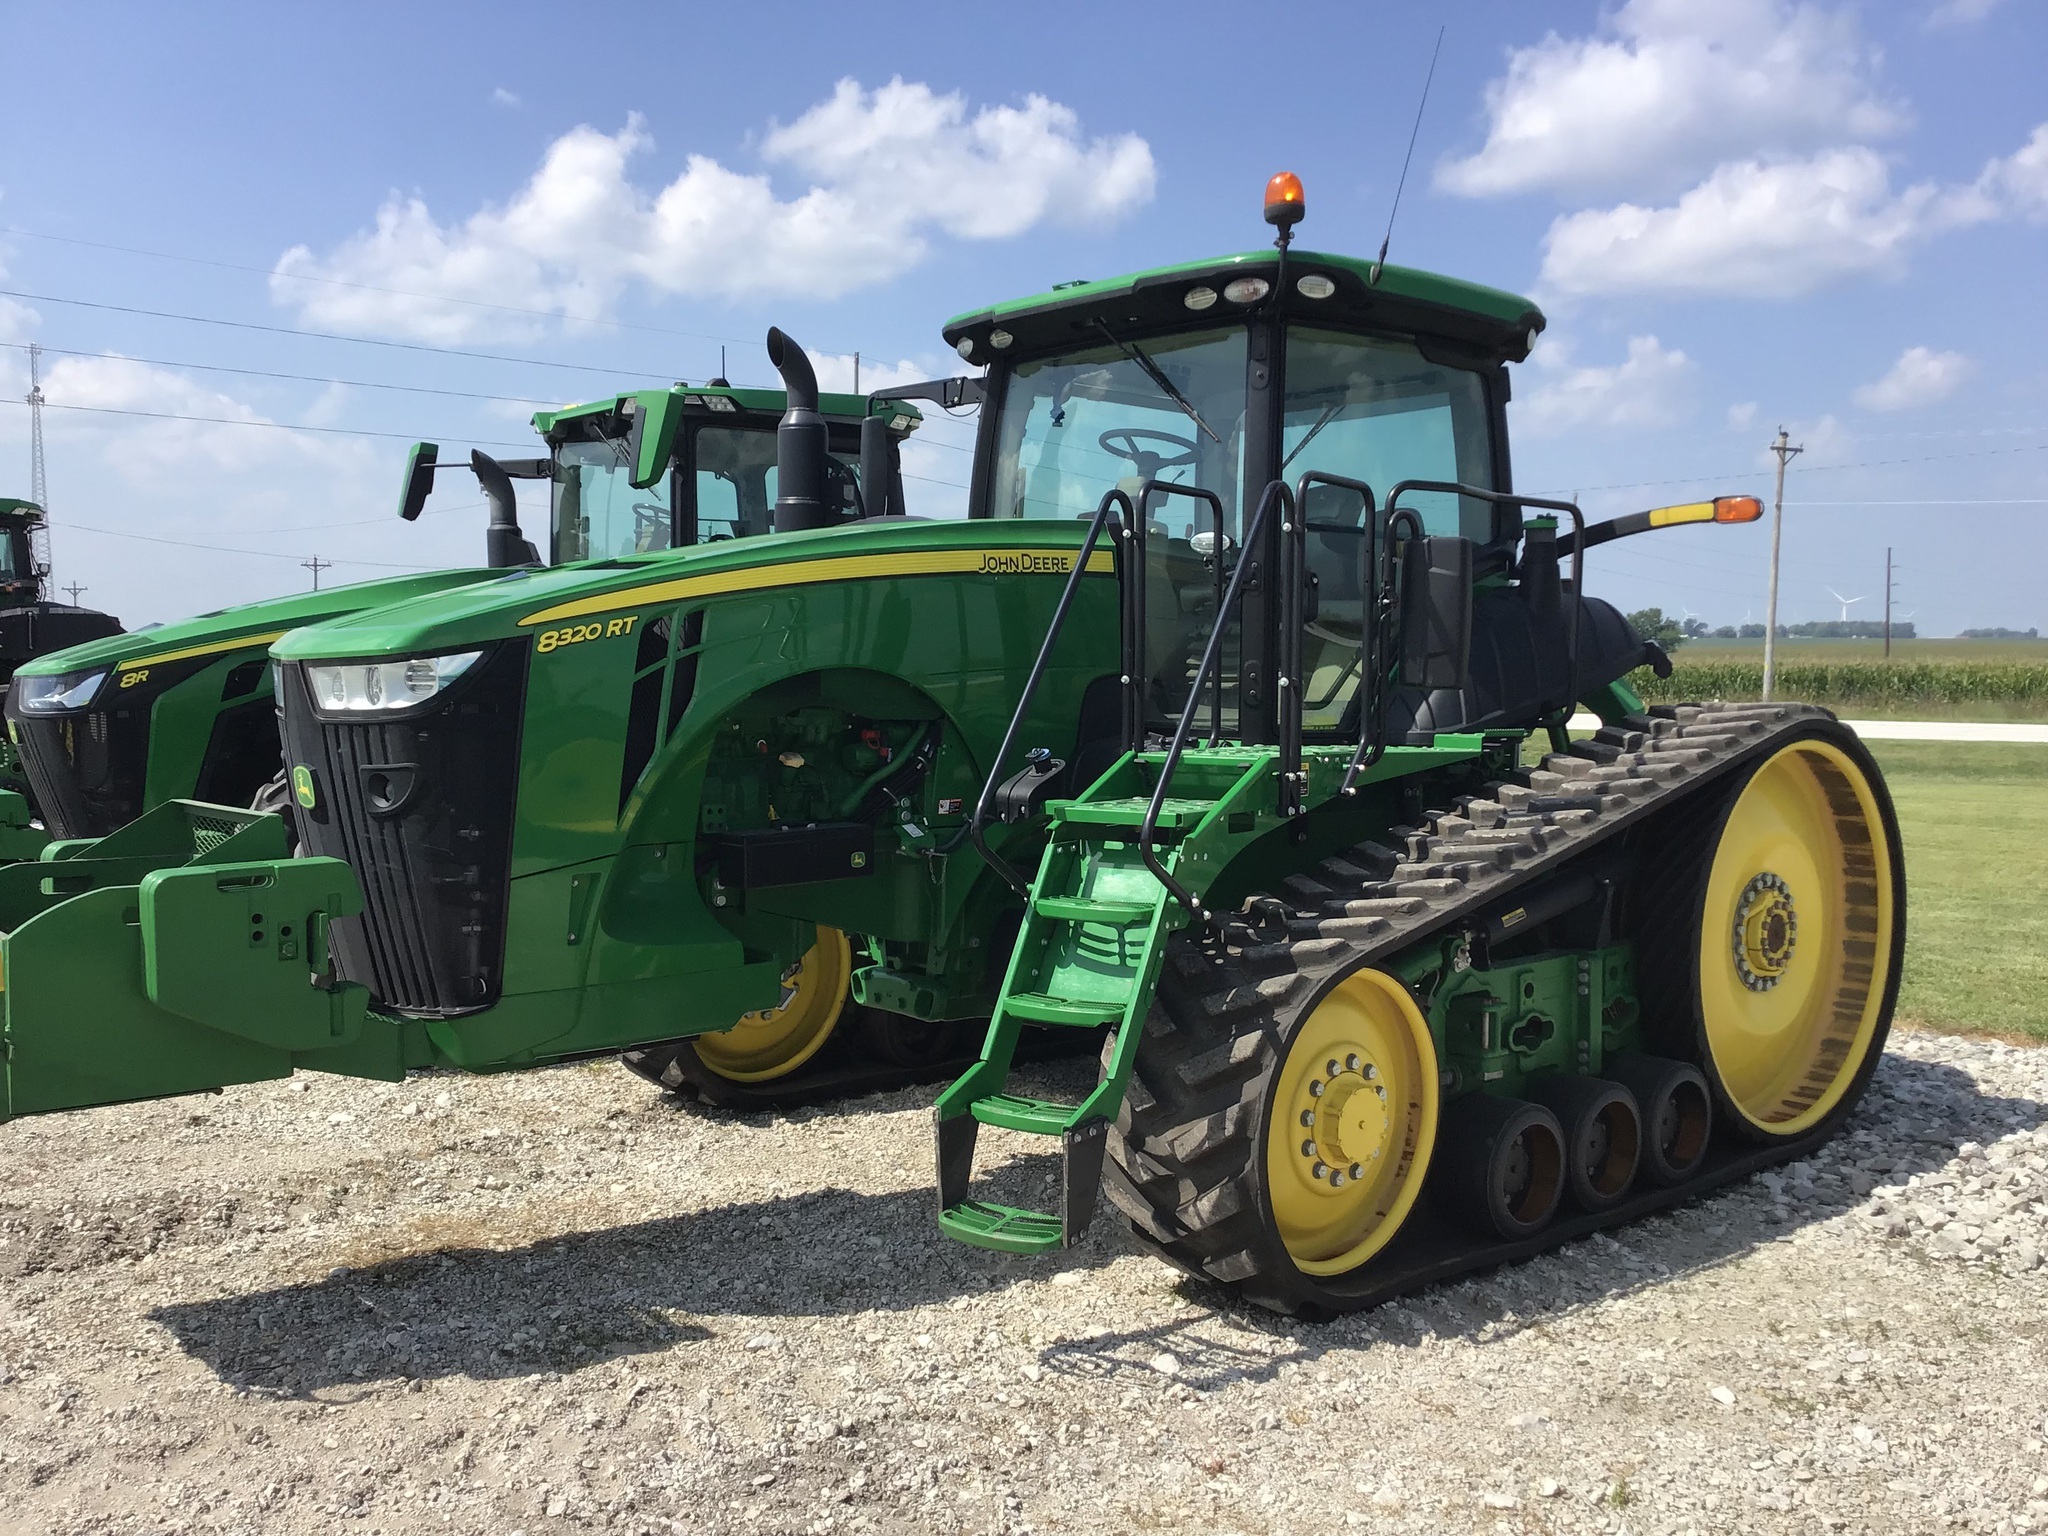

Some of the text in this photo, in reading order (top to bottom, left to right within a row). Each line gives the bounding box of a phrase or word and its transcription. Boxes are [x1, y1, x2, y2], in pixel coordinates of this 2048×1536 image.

[537, 615, 639, 653] 8320 RT
[120, 669, 150, 688] 8R
